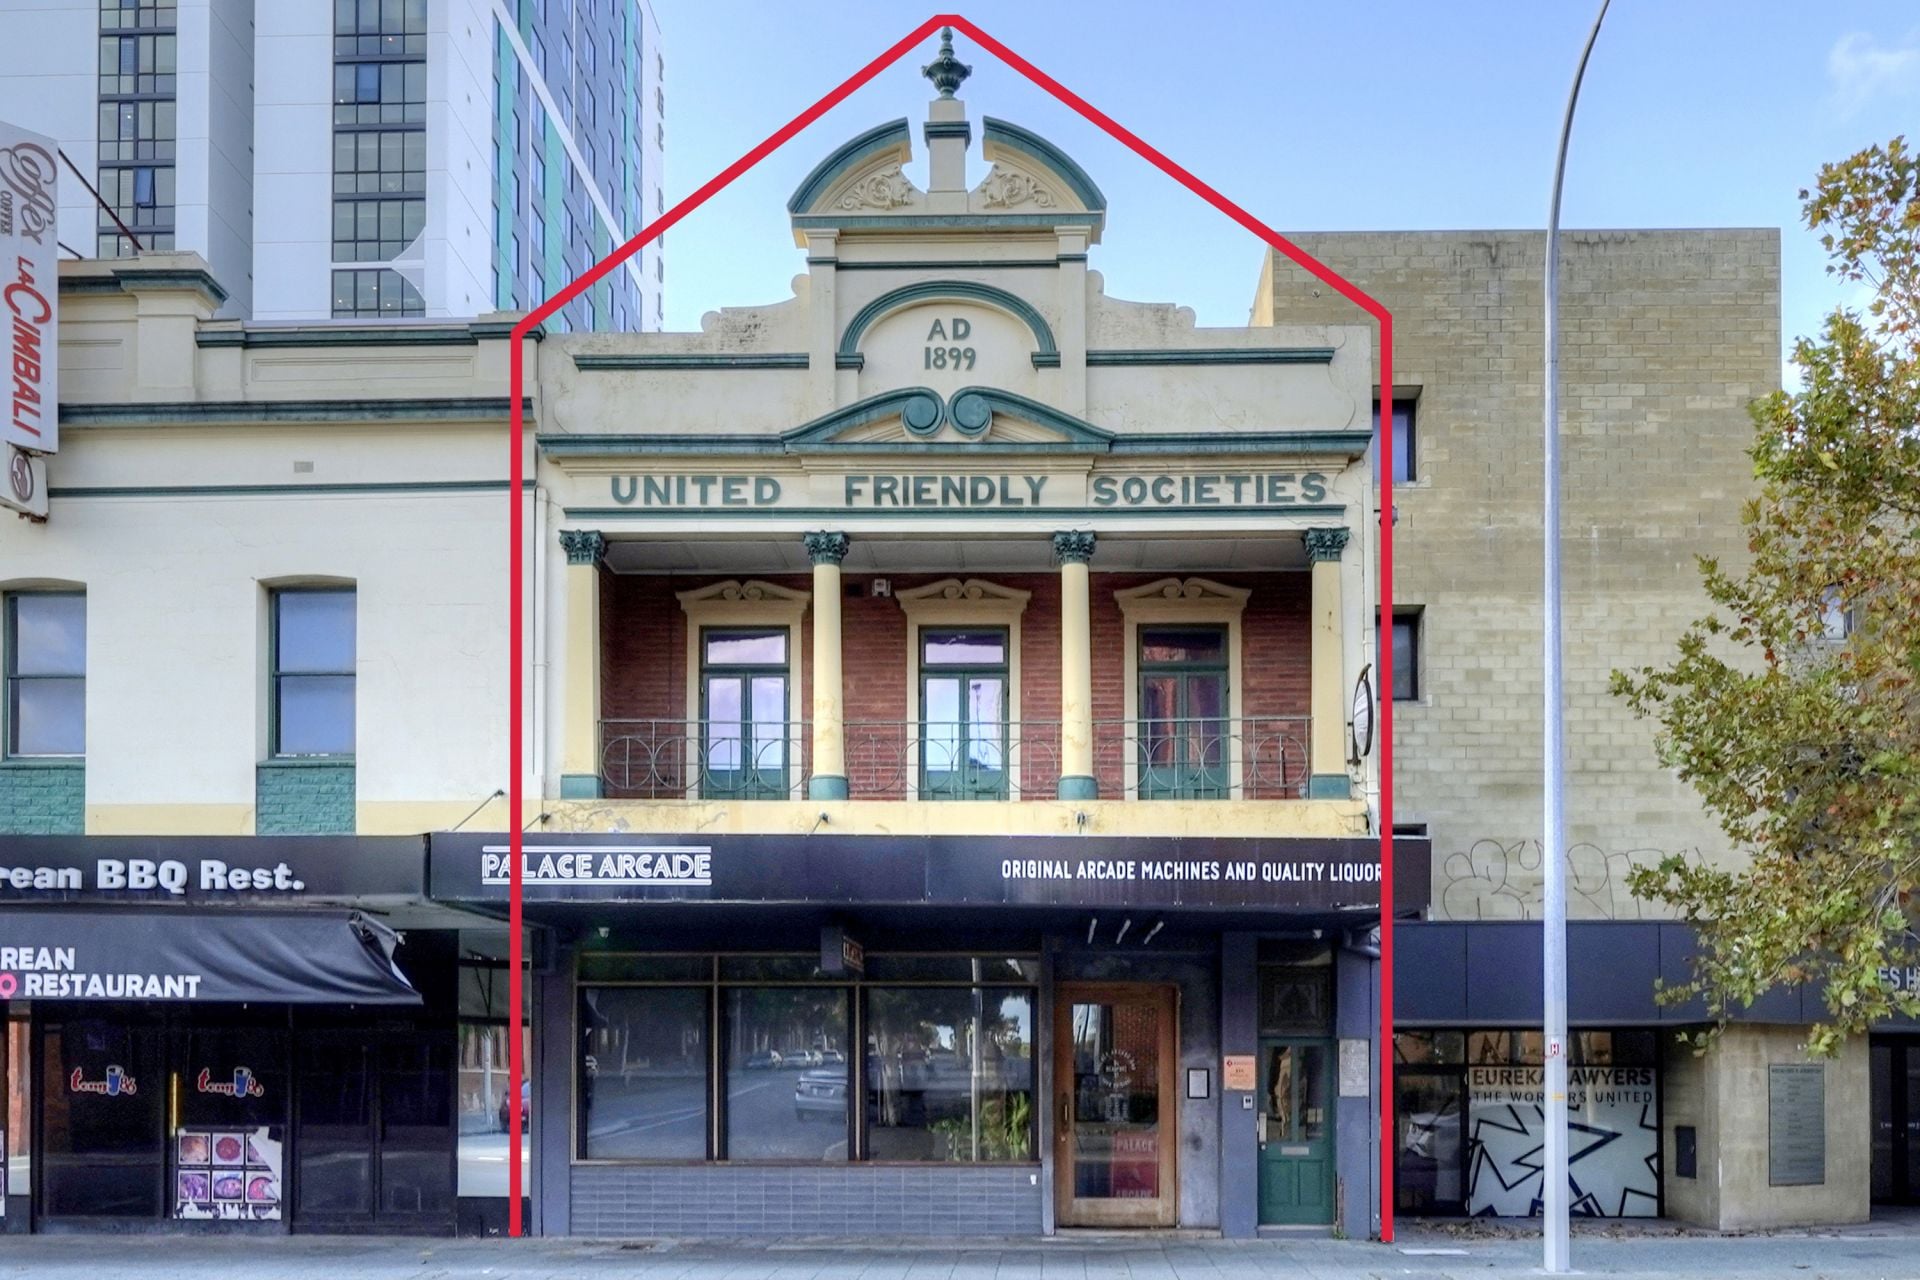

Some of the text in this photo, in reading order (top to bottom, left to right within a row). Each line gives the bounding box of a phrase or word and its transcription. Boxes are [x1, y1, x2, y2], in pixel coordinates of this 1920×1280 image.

[927, 318, 971, 341] AD
[3, 256, 52, 438] LA CIMBALI
[924, 346, 977, 371] 1899
[611, 473, 1328, 507] UNITED FRIENDLY SOCIETIES
[97, 859, 188, 895] BBQ
[200, 859, 305, 891] Rest.
[598, 853, 711, 879] ARCADE
[1001, 859, 1382, 883] ORIGINAL ARCADE MACHINES AND QUALITY LIQUOR
[1, 947, 76, 971] REAN
[24, 974, 201, 998] RESTAURANT
[1568, 1068, 1651, 1086] AWYERS
[1475, 1091, 1652, 1103] THE WORRS UNITED
